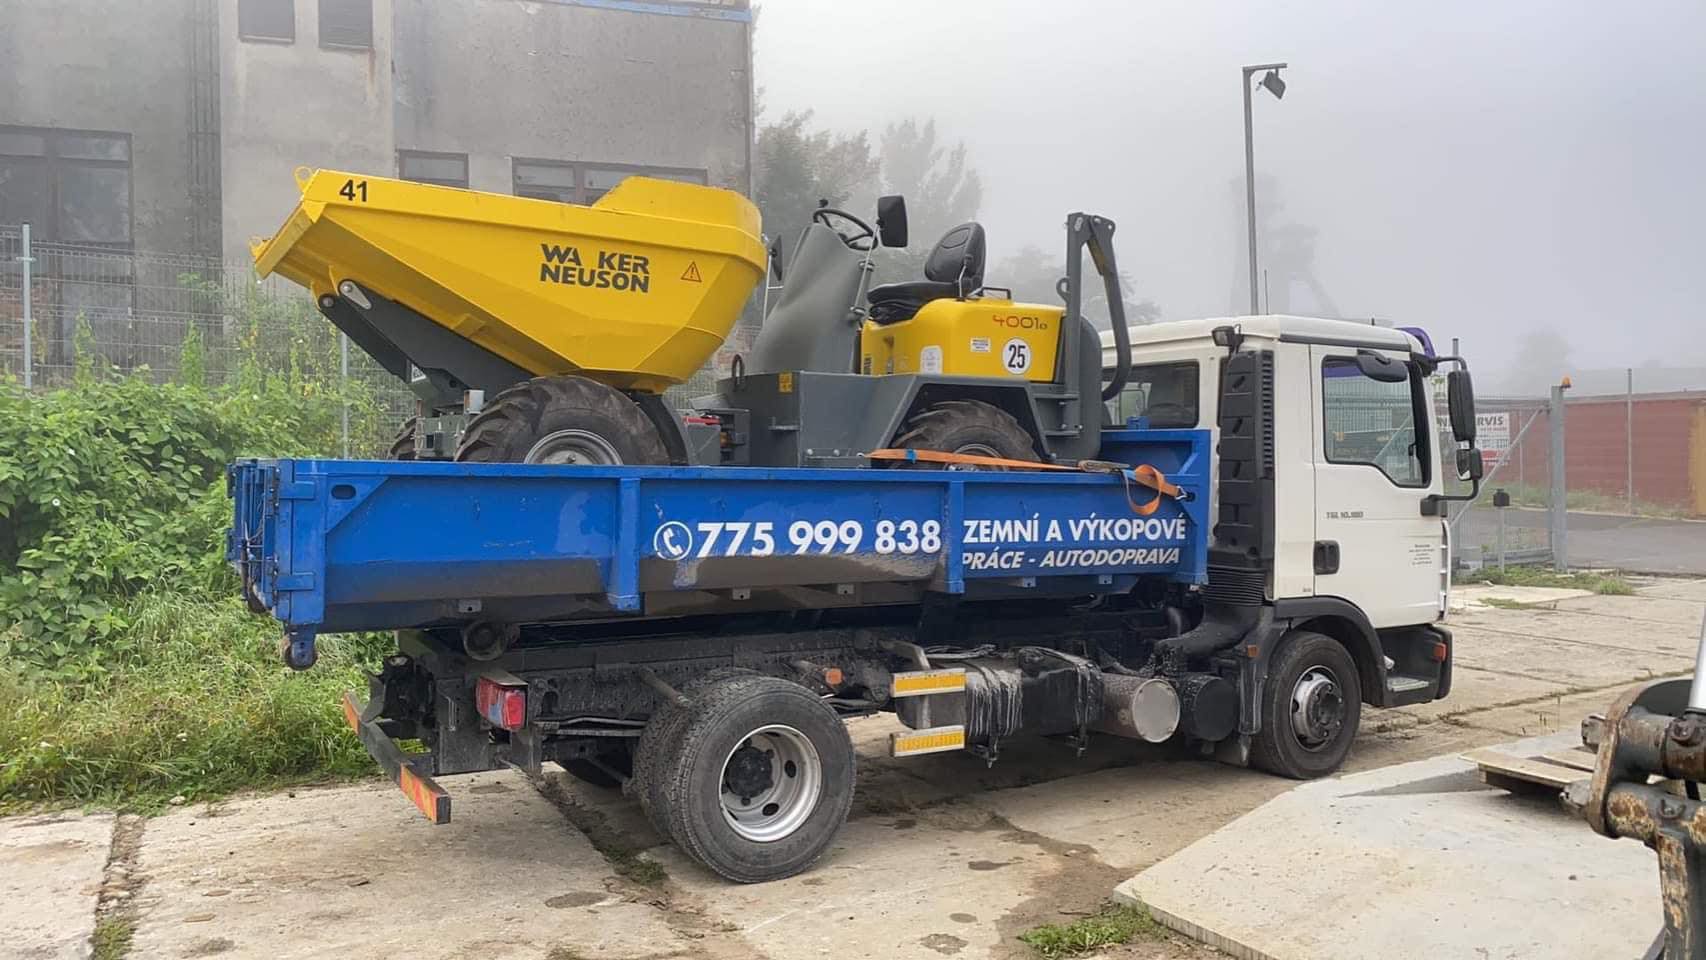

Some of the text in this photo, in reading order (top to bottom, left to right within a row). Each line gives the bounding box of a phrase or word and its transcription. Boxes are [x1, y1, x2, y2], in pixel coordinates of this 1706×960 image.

[339, 179, 368, 202] 41
[540, 263, 650, 293] NEUSON
[1007, 344, 1027, 369] 25
[697, 519, 942, 558] 775 999 838
[963, 512, 1187, 543] ZEMNÍ A VÝKOPOVÉ
[962, 546, 1023, 569] PRÁCE
[1039, 547, 1180, 568] AUTODOPRAVA
